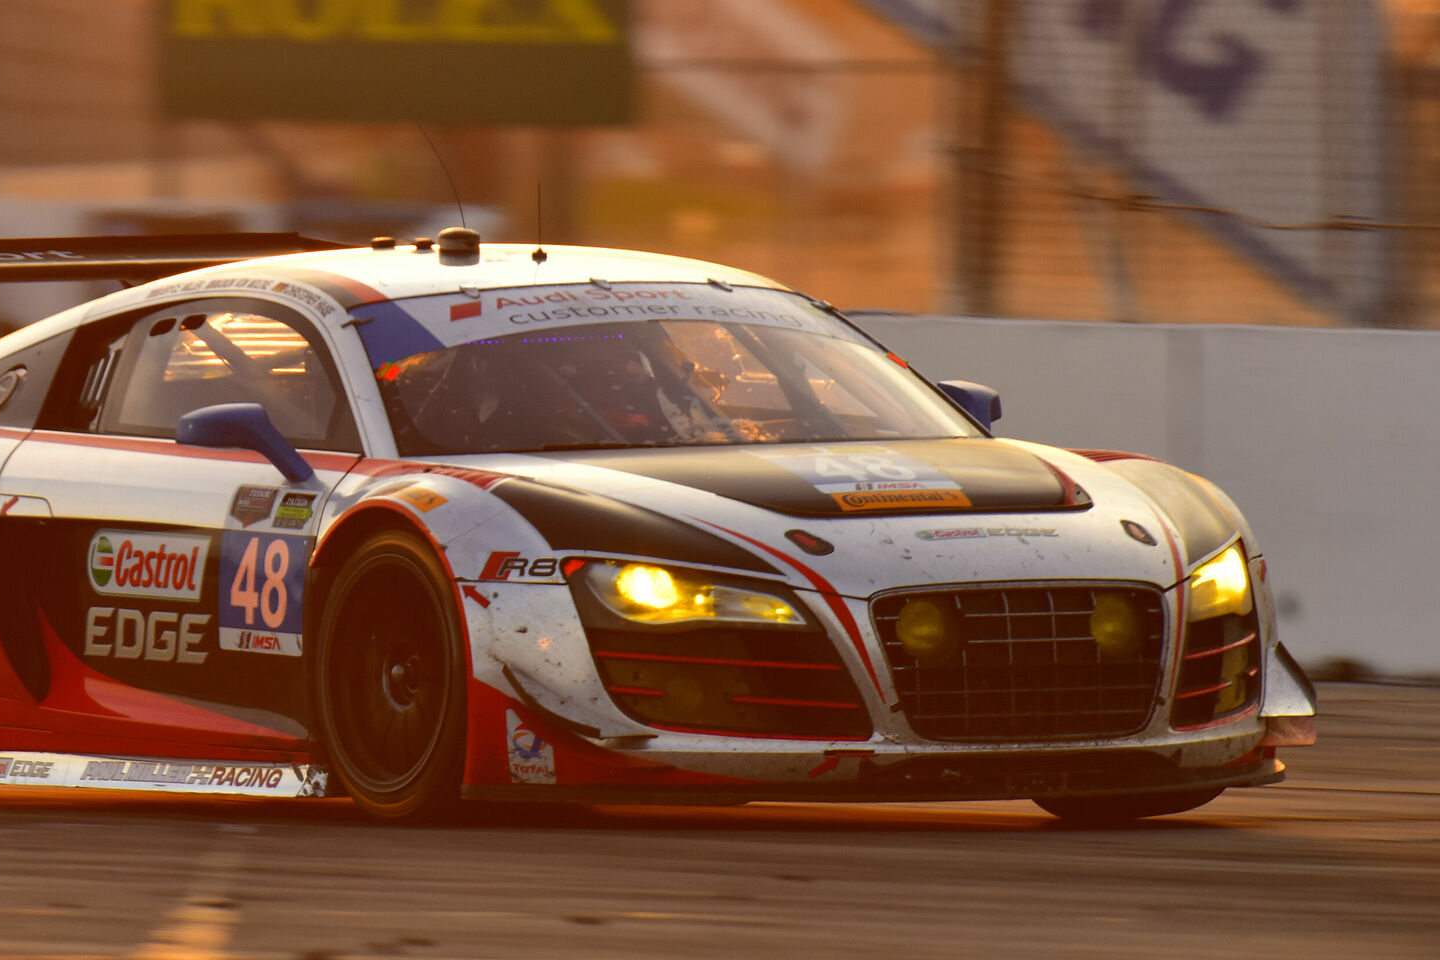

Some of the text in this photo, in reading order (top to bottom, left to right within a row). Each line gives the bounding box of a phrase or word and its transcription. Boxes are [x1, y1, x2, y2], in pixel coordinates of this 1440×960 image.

[496, 288, 694, 309] Audi Sport
[509, 304, 804, 328] customer racing
[815, 455, 918, 481] 48
[841, 491, 944, 507] Continental
[934, 529, 979, 538] Castrol
[115, 539, 200, 591] Castrol
[497, 557, 558, 578] R8
[230, 536, 290, 628] 48
[83, 606, 213, 665] EDGE
[251, 635, 282, 651] IMSA
[9, 760, 55, 779] EDGE
[210, 766, 283, 789] RACING
[512, 763, 549, 774] TOTAL
